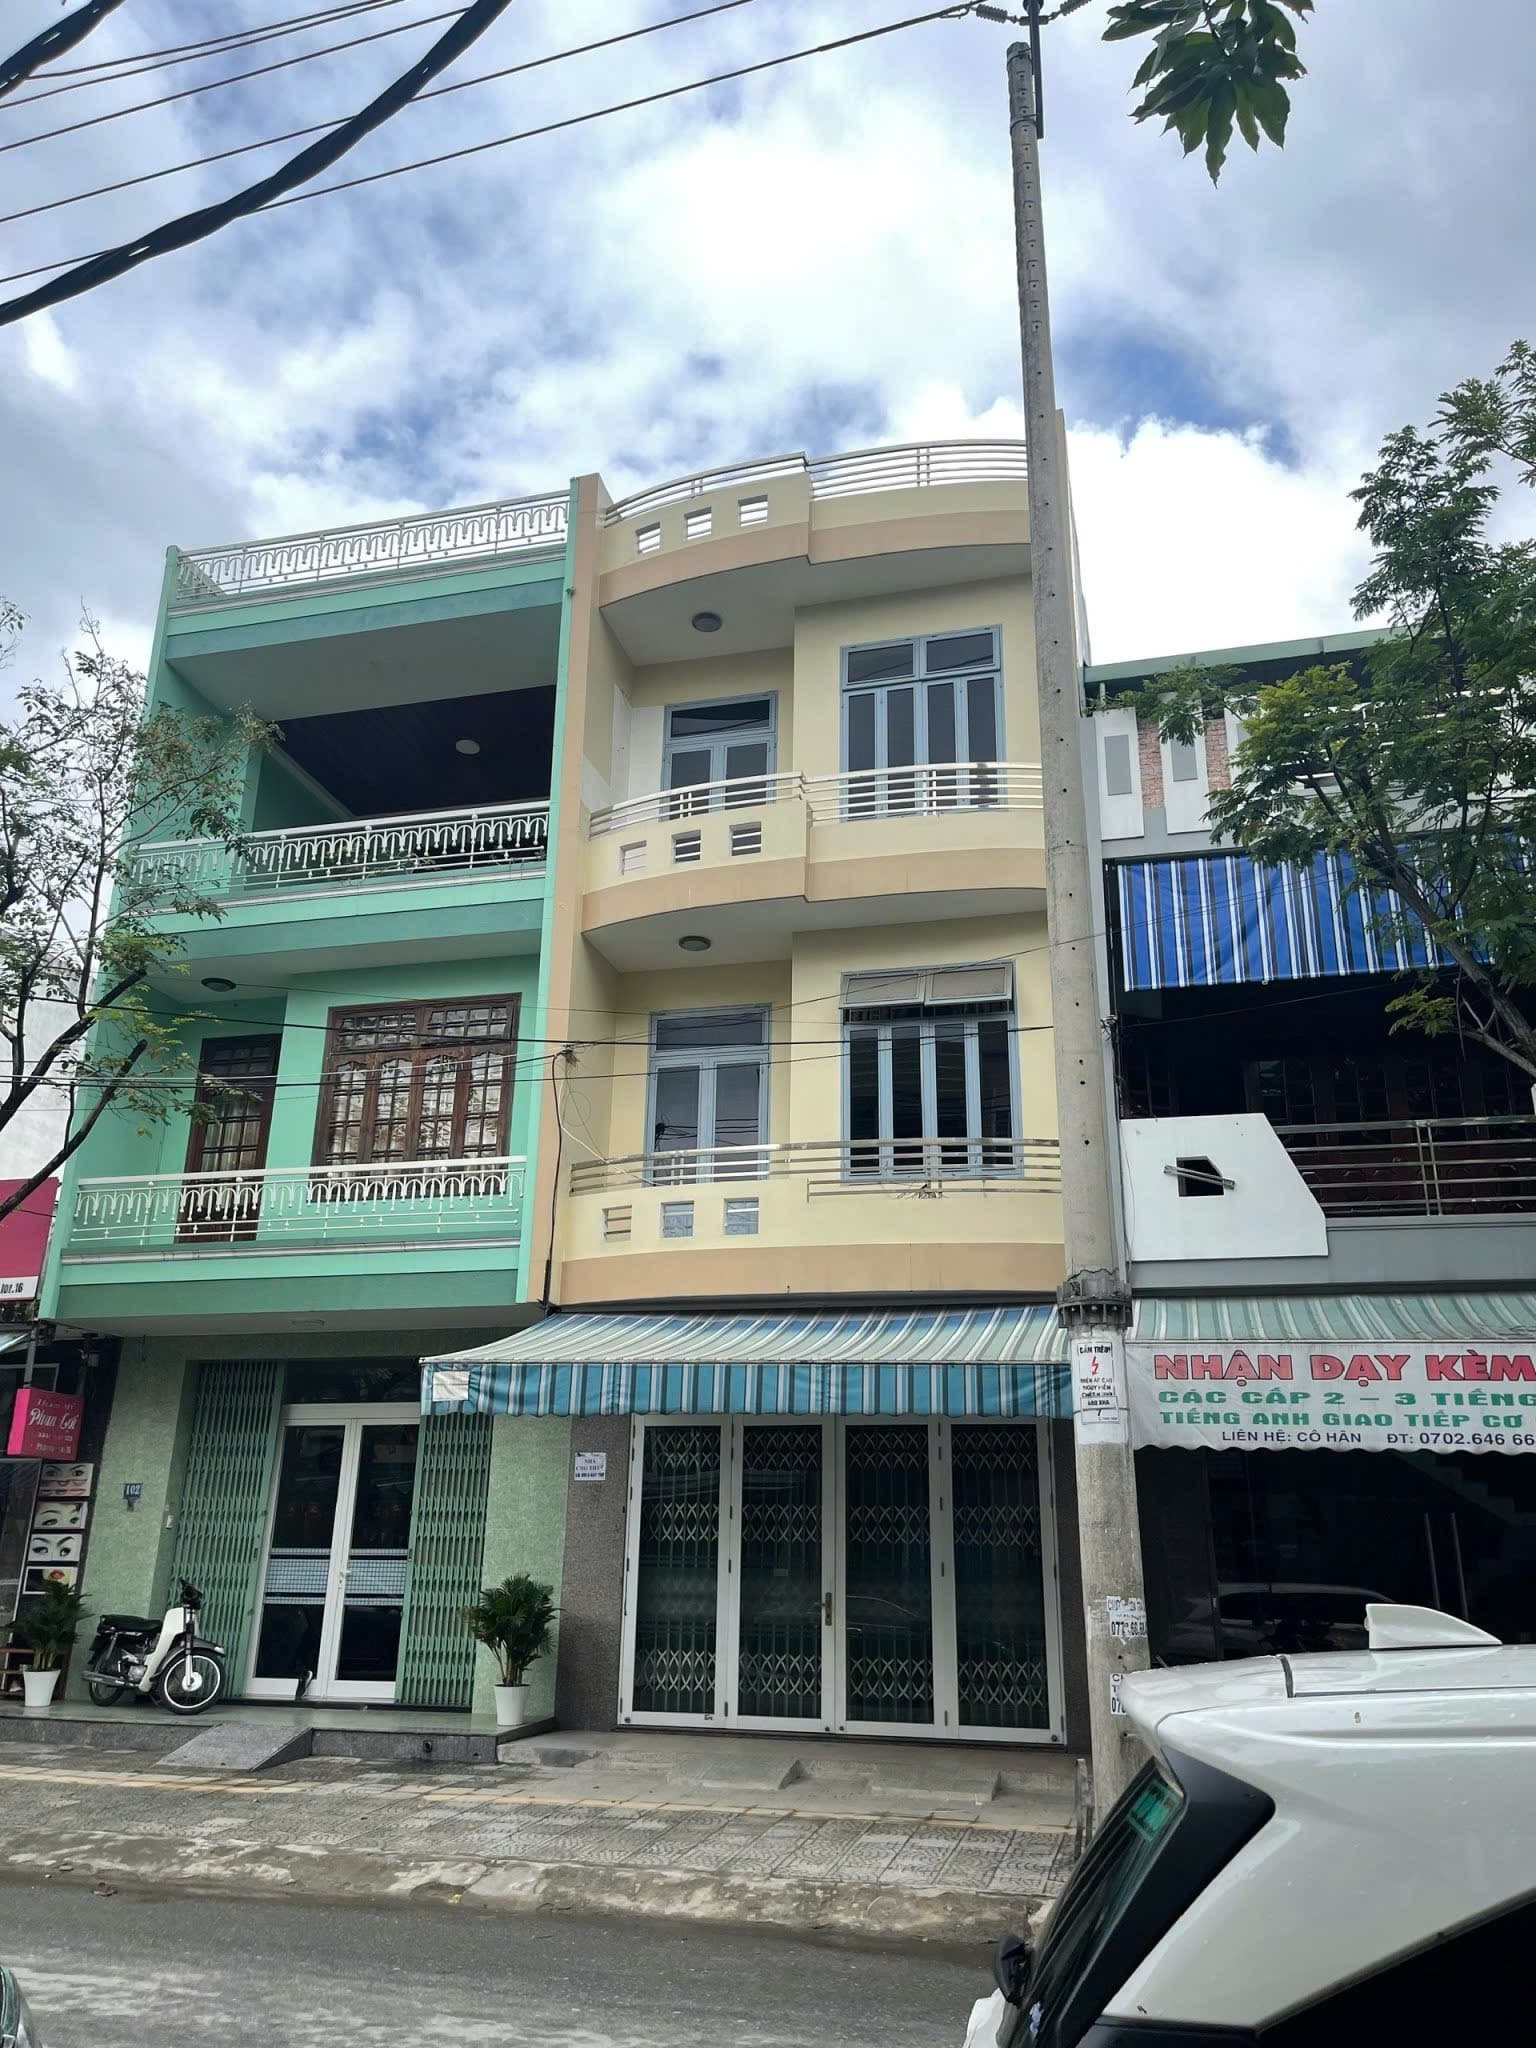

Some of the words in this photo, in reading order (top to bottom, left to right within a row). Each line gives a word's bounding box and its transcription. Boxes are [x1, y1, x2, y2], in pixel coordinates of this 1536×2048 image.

[1154, 1350, 1293, 1387] NHẬN
[1310, 1354, 1411, 1387] DẠY
[1425, 1349, 1536, 1381] KÈM
[1158, 1389, 1227, 1404] CÁC
[1241, 1387, 1311, 1404] CẤP
[1323, 1392, 1345, 1405] 2
[1394, 1392, 1417, 1405] 3
[1160, 1407, 1240, 1425] TIẾNG
[1252, 1412, 1309, 1425] ANH
[1322, 1413, 1392, 1426] GIAO
[1404, 1410, 1470, 1427] TIẾP
[1482, 1414, 1522, 1428] CƠ
[1222, 1429, 1258, 1441] LIÊN
[1264, 1429, 1291, 1444] HỆ:
[1297, 1429, 1321, 1442] CÔ
[1327, 1430, 1361, 1443] HÂN
[1387, 1433, 1414, 1444] ĐT:
[1419, 1432, 1505, 1446] 0702.646
[126, 1485, 140, 1495] 102
